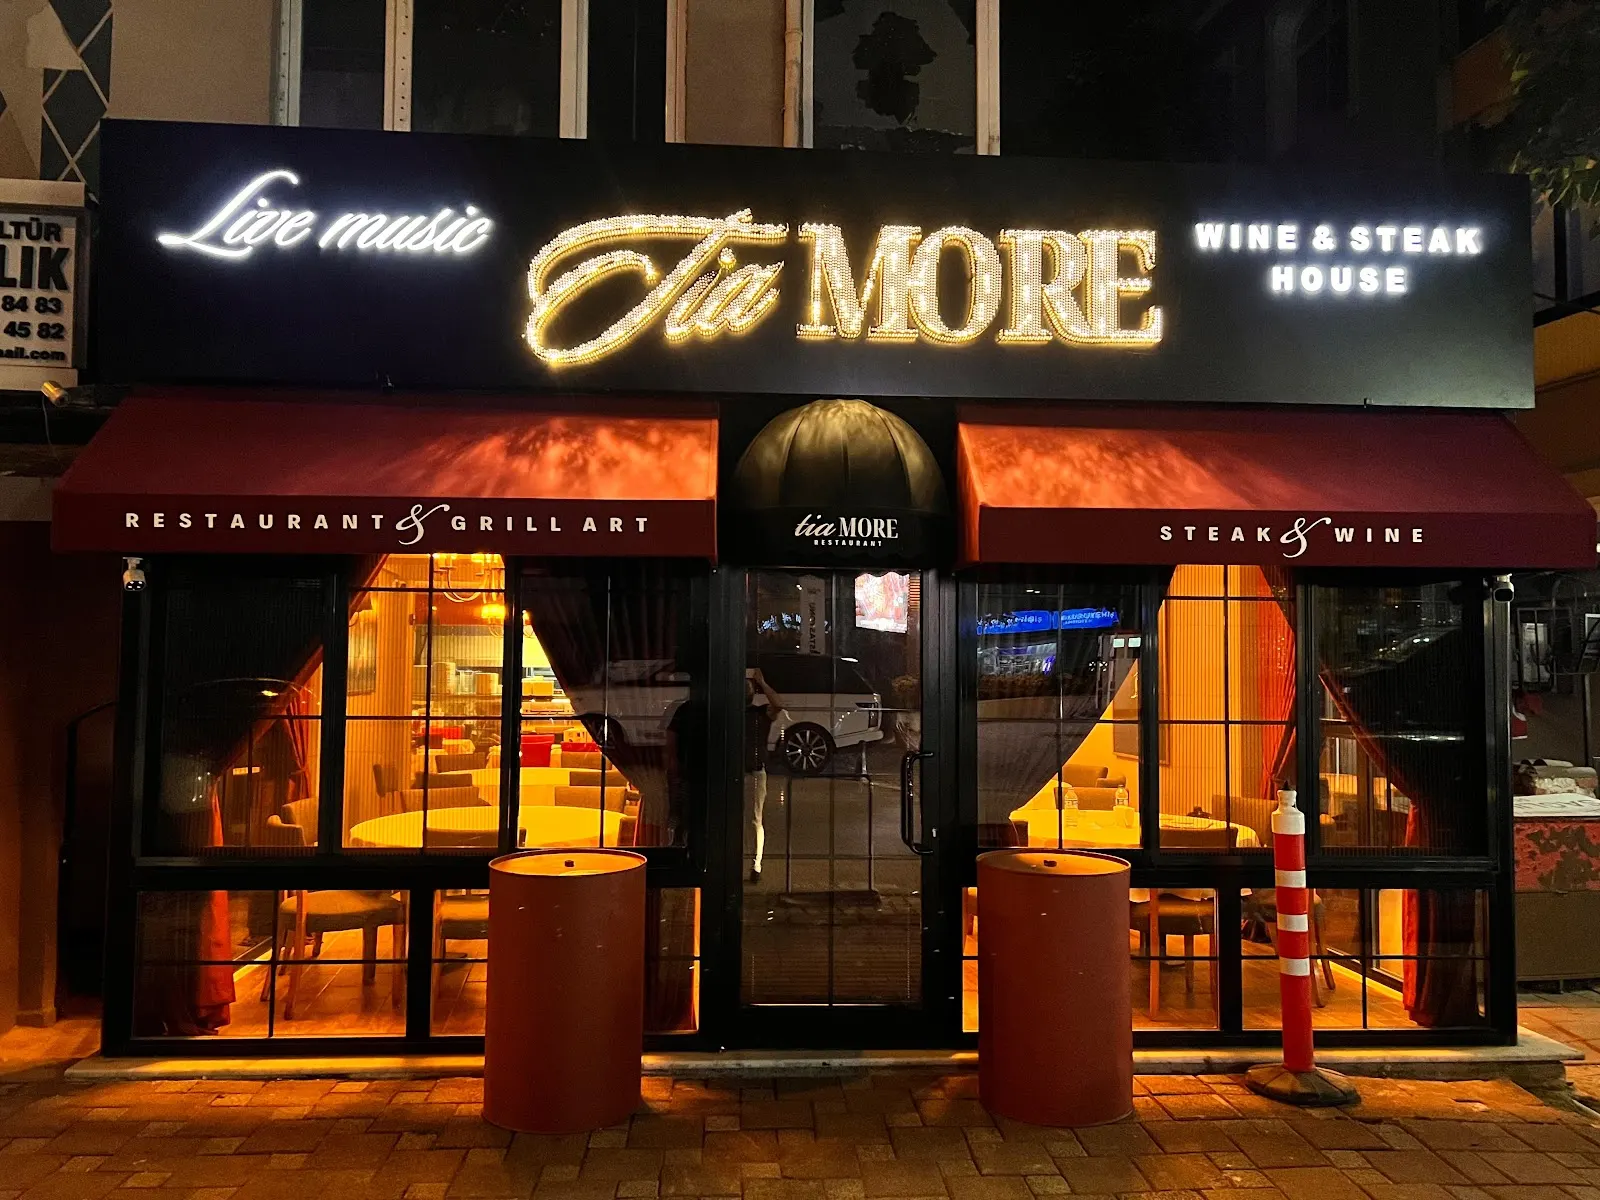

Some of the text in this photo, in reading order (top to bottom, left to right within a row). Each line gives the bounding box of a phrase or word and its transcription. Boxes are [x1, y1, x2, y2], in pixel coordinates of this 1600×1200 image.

[157, 169, 493, 257] Live music
[1194, 222, 1482, 254] WINE & STEAK
[796, 222, 1163, 344] MORE
[1271, 265, 1407, 293] HOUSE
[2, 295, 63, 314] 84 83
[4, 321, 65, 339] 45 82
[125, 503, 648, 546] RESTAURANT & GRILL ART
[794, 513, 899, 539] tia MORE
[1159, 517, 1423, 558] STEAK & WINE
[813, 539, 882, 547] RESTAURANT
